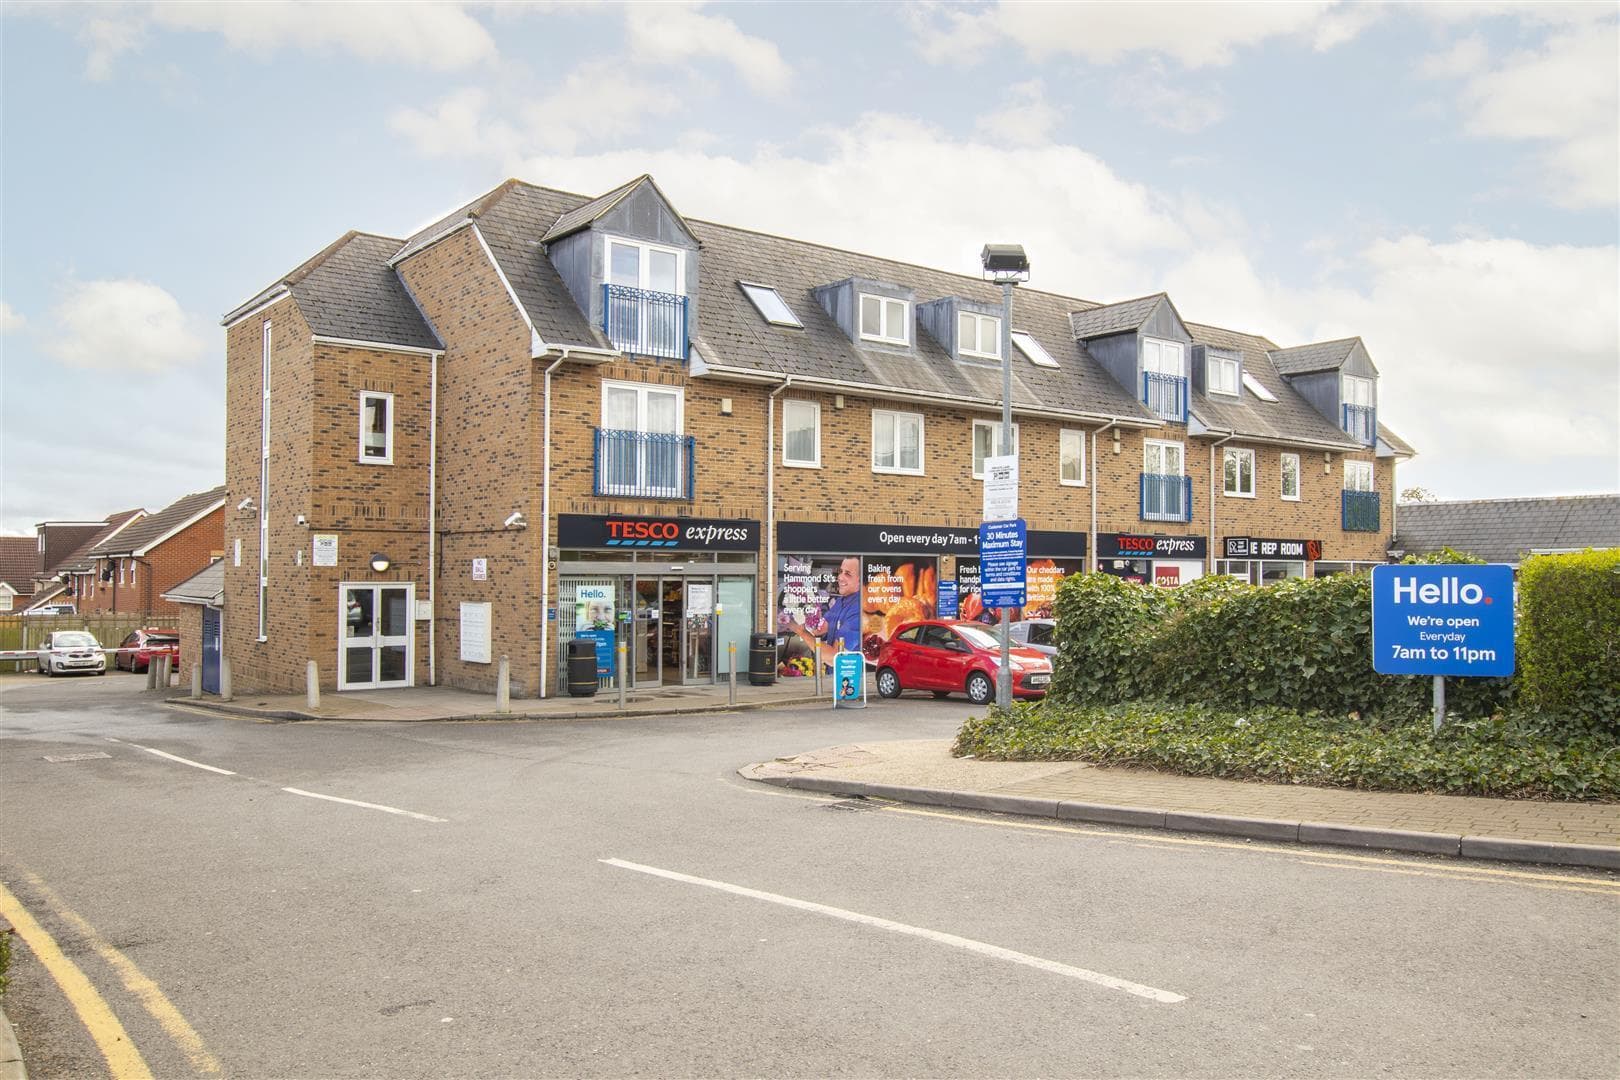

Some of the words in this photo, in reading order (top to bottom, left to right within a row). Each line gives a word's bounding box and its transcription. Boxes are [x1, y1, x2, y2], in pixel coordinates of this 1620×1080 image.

[606, 521, 679, 538] TESCO
[685, 525, 748, 544] express
[996, 531, 1018, 540] Minutes
[880, 531, 904, 545] Open
[906, 534, 930, 546] every
[932, 533, 948, 546] day
[948, 534, 967, 544] 7am
[982, 541, 1010, 549] Maximum
[1010, 540, 1023, 548] Stay
[1118, 538, 1154, 550] TESCO
[1156, 538, 1195, 554] express
[1262, 542, 1277, 554] REP
[1280, 543, 1303, 556] ROOM
[784, 564, 812, 574] Serving
[868, 564, 891, 574] Baking
[960, 566, 977, 574] Fresh
[1026, 566, 1038, 574] Our
[1038, 566, 1064, 574] cheddars
[784, 574, 822, 582] Hammond
[823, 574, 836, 582] St's
[868, 574, 886, 582] fresh
[887, 574, 904, 582] from
[1156, 576, 1178, 585] COSTA
[580, 590, 606, 598] Hello.
[784, 585, 818, 594] shoppers
[1394, 577, 1492, 604] Hello.
[789, 595, 806, 603] little
[808, 595, 830, 603] better
[888, 595, 900, 604] day
[806, 606, 818, 616] day
[1408, 616, 1444, 626] We're
[1446, 618, 1480, 628] open
[1420, 632, 1466, 643] Everyday
[1392, 646, 1426, 659] 7am
[1430, 647, 1448, 660] to
[1452, 646, 1496, 664] 11pm
